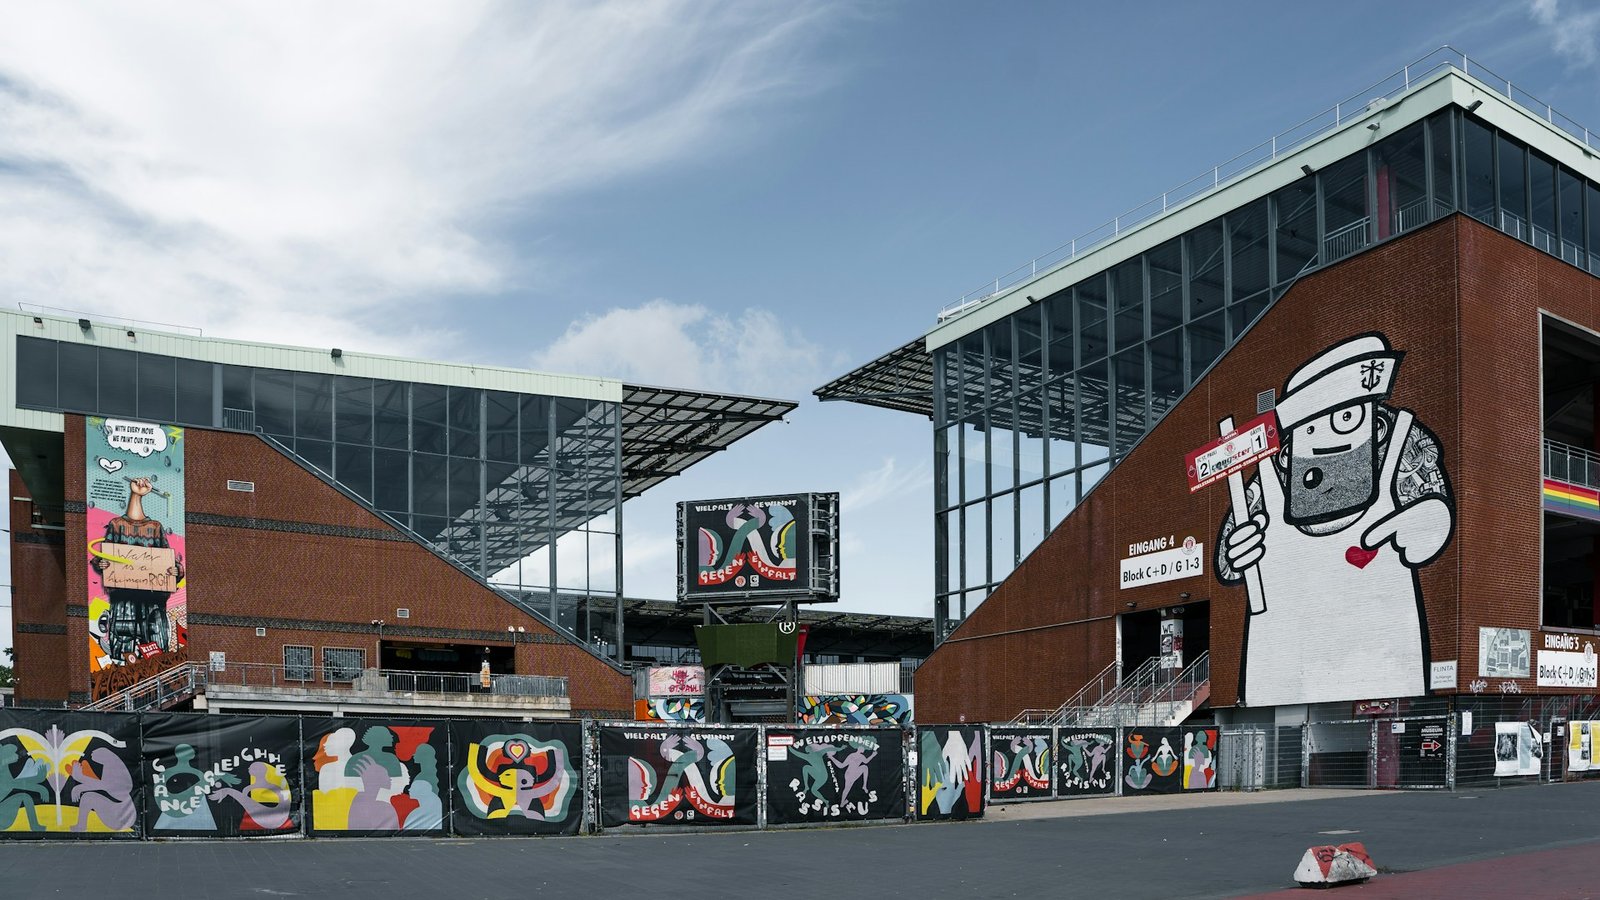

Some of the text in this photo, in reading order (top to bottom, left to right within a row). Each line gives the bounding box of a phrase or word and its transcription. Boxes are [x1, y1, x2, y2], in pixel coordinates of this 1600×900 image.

[1255, 435, 1262, 449] 1
[1200, 462, 1209, 477] 2
[754, 500, 797, 508] GEWINNT
[1129, 537, 1167, 556] EINGANG
[1169, 535, 1175, 547] 4
[118, 549, 161, 561] Water
[1123, 567, 1145, 582] Block
[1175, 560, 1182, 573] G
[1186, 557, 1200, 571] 1-3
[1544, 634, 1574, 650] EINGANG
[1539, 664, 1557, 679] Block
[690, 733, 735, 741] GEWINNT
[631, 794, 681, 819] GEGEN
